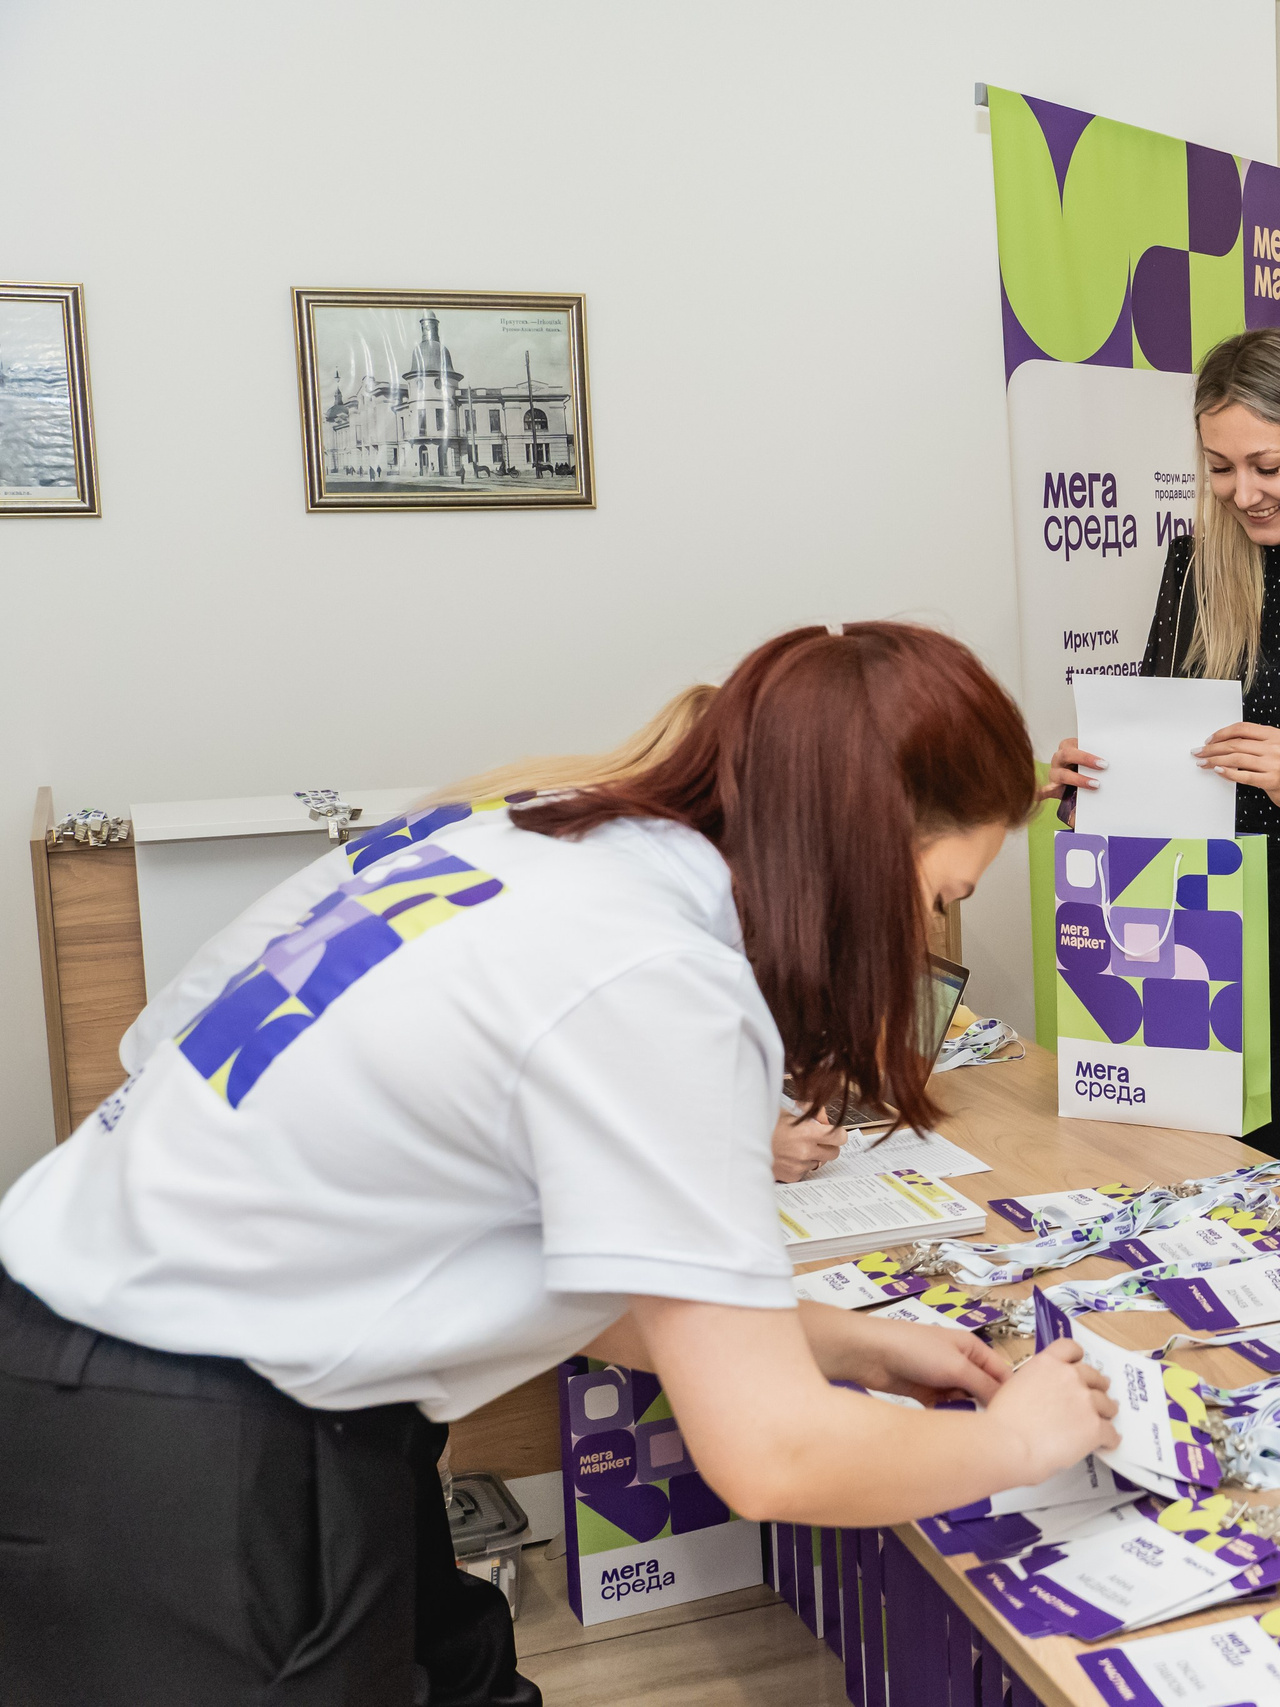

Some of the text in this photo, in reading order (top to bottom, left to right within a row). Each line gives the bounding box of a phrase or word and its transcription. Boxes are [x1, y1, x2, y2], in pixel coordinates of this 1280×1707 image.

[1154, 471, 1180, 484] Форум
[1182, 474, 1195, 484] для
[1043, 472, 1118, 509] мега
[1155, 490, 1196, 501] продавцов
[1044, 514, 1138, 562] среда
[1064, 630, 1118, 652] Иркутск
[1060, 923, 1090, 938] мега
[1060, 936, 1106, 950] маркет
[1076, 1060, 1130, 1084] мега
[1075, 1079, 1146, 1106] среда
[1124, 1363, 1140, 1412] среда
[580, 1450, 614, 1466] мега
[580, 1456, 632, 1476] маркет
[600, 1558, 660, 1584] мега
[600, 1571, 676, 1602] среда
